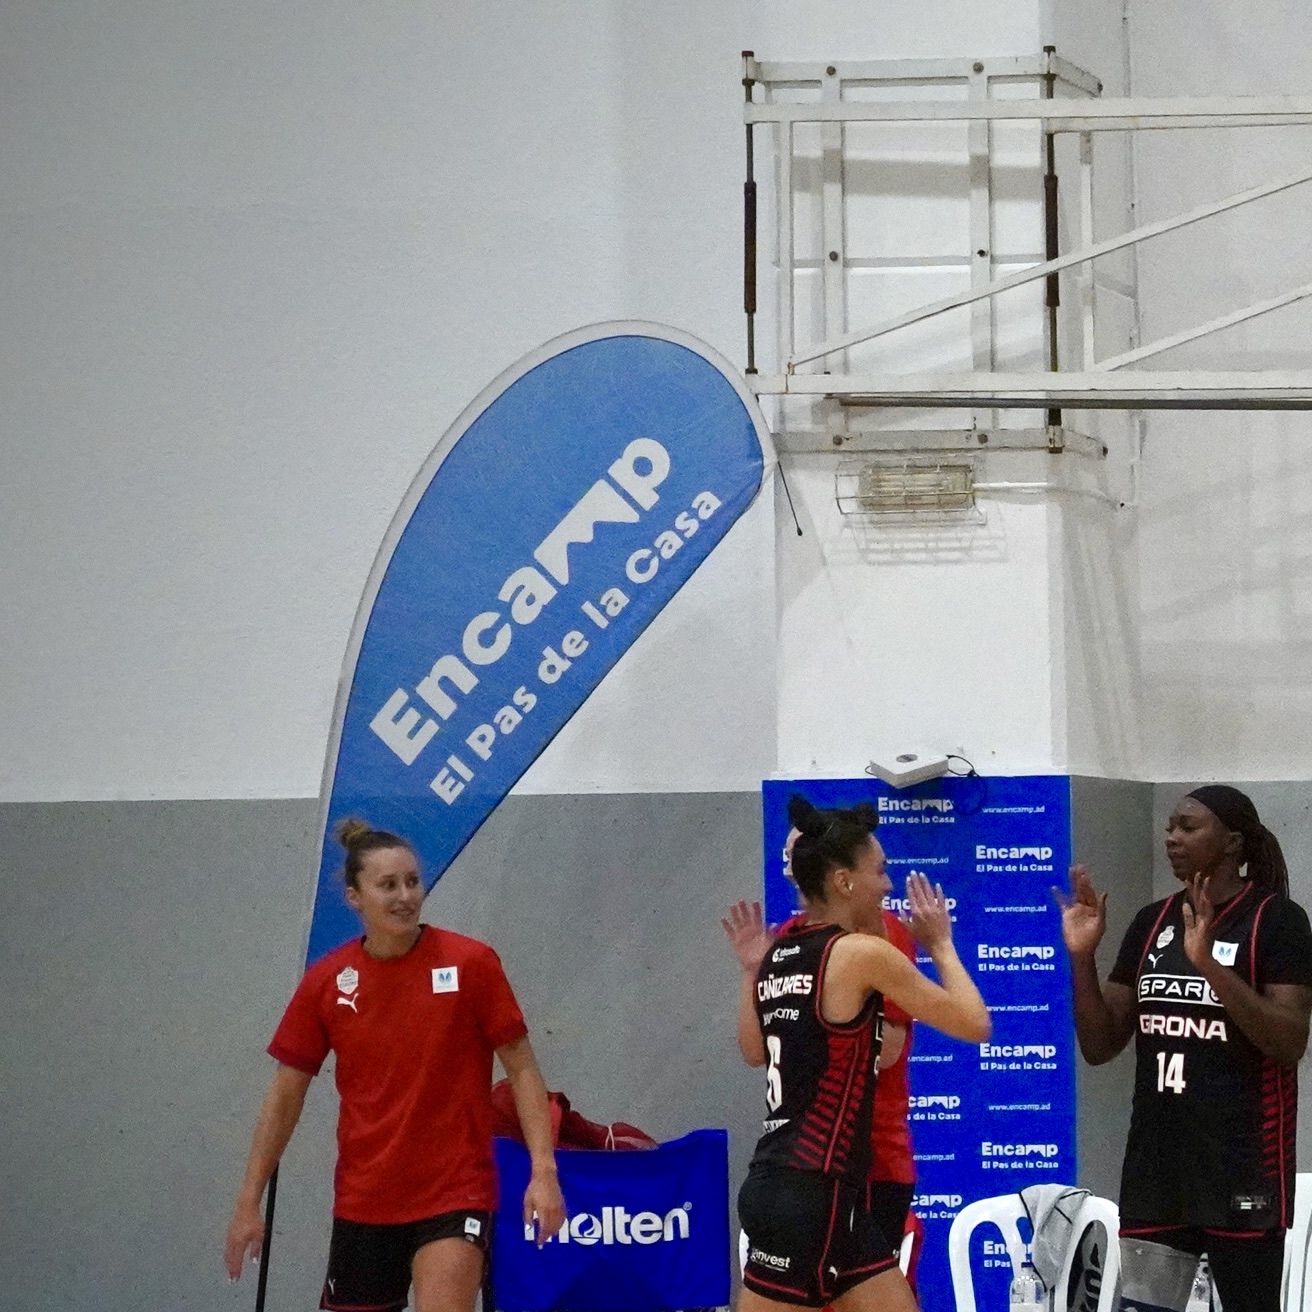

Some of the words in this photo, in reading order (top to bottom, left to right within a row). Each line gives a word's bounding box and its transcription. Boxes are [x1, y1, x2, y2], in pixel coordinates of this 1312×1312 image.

[368, 437, 671, 767] Encamp
[430, 756, 474, 805] El
[465, 685, 538, 762] Pas
[536, 629, 589, 685] de
[581, 586, 630, 630] la
[625, 490, 722, 584] Casa
[878, 797, 954, 812] Encamp
[982, 805, 1046, 814] www.encamp.ad
[878, 815, 887, 825] El
[889, 815, 905, 825] Pas
[907, 815, 920, 825] de
[922, 815, 930, 825] la
[932, 815, 955, 825] Casa
[976, 845, 1053, 861] Encamp
[886, 857, 949, 865] www.encamp.ad
[976, 864, 985, 873] El
[987, 864, 1003, 873] Pas
[1005, 864, 1018, 873] de
[1020, 864, 1028, 873] la
[1030, 864, 1053, 873] Casa
[881, 896, 957, 911] Encp
[984, 905, 1047, 913] www.encamp.ad
[978, 944, 1055, 960] Encamp
[978, 963, 987, 972] El
[988, 963, 1005, 972] Pas
[1007, 963, 1020, 972] de
[1021, 963, 1030, 972] la
[1032, 963, 1055, 972] Casa
[757, 973, 814, 1002] CAÑIZARES
[1140, 979, 1203, 998] SPAR
[986, 1003, 1049, 1012] www.encamp.ad
[1139, 1014, 1229, 1042] GRONA
[979, 1043, 1056, 1059] Encamp
[907, 1054, 953, 1063] .encamp.ad
[980, 1062, 989, 1071] El
[990, 1062, 1007, 1071] Pas
[1009, 1062, 1022, 1071] de
[1023, 1062, 1032, 1071] la
[1034, 1062, 1057, 1071] Casa
[1156, 1051, 1186, 1094] 14
[908, 1096, 960, 1110] camp
[988, 1102, 1051, 1111] www.encamp.ad
[913, 1112, 926, 1121] de
[928, 1112, 936, 1121] la
[938, 1112, 961, 1121] Casa
[982, 1142, 1059, 1158] Encamp
[913, 1153, 955, 1162] encamp.ad
[982, 1160, 991, 1170] El
[992, 1160, 1009, 1170] Pas
[1011, 1160, 1024, 1170] de
[1025, 1160, 1034, 1170] la
[1036, 1160, 1059, 1170] Casa
[911, 1195, 962, 1207] camp
[929, 1211, 939, 1219] la
[940, 1211, 959, 1219] Cas
[984, 1260, 993, 1268] El
[994, 1260, 1010, 1268] Pas
